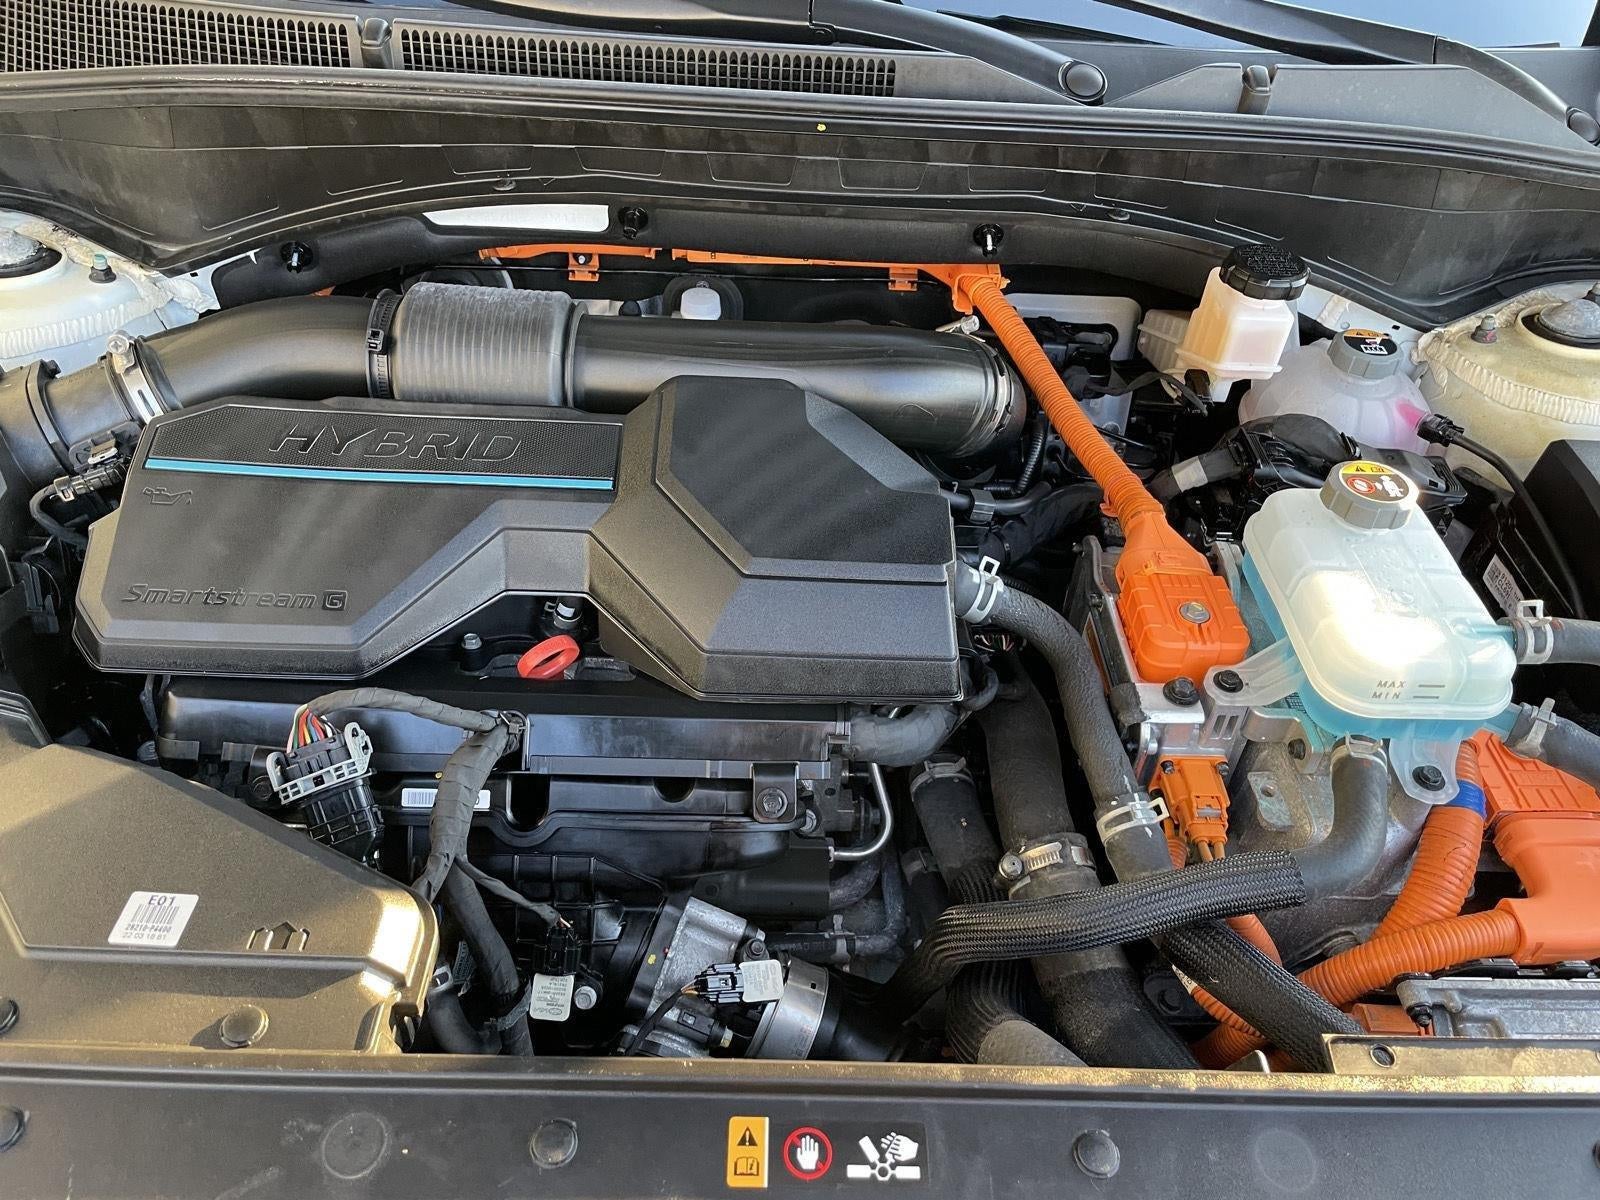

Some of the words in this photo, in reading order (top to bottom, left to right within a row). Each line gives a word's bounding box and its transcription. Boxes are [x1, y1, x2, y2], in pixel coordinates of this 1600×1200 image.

[269, 424, 522, 462] HYBRID
[122, 583, 317, 609] Smartstream
[324, 591, 346, 609] G
[1376, 680, 1406, 689] MAX
[1371, 691, 1401, 700] MIN
